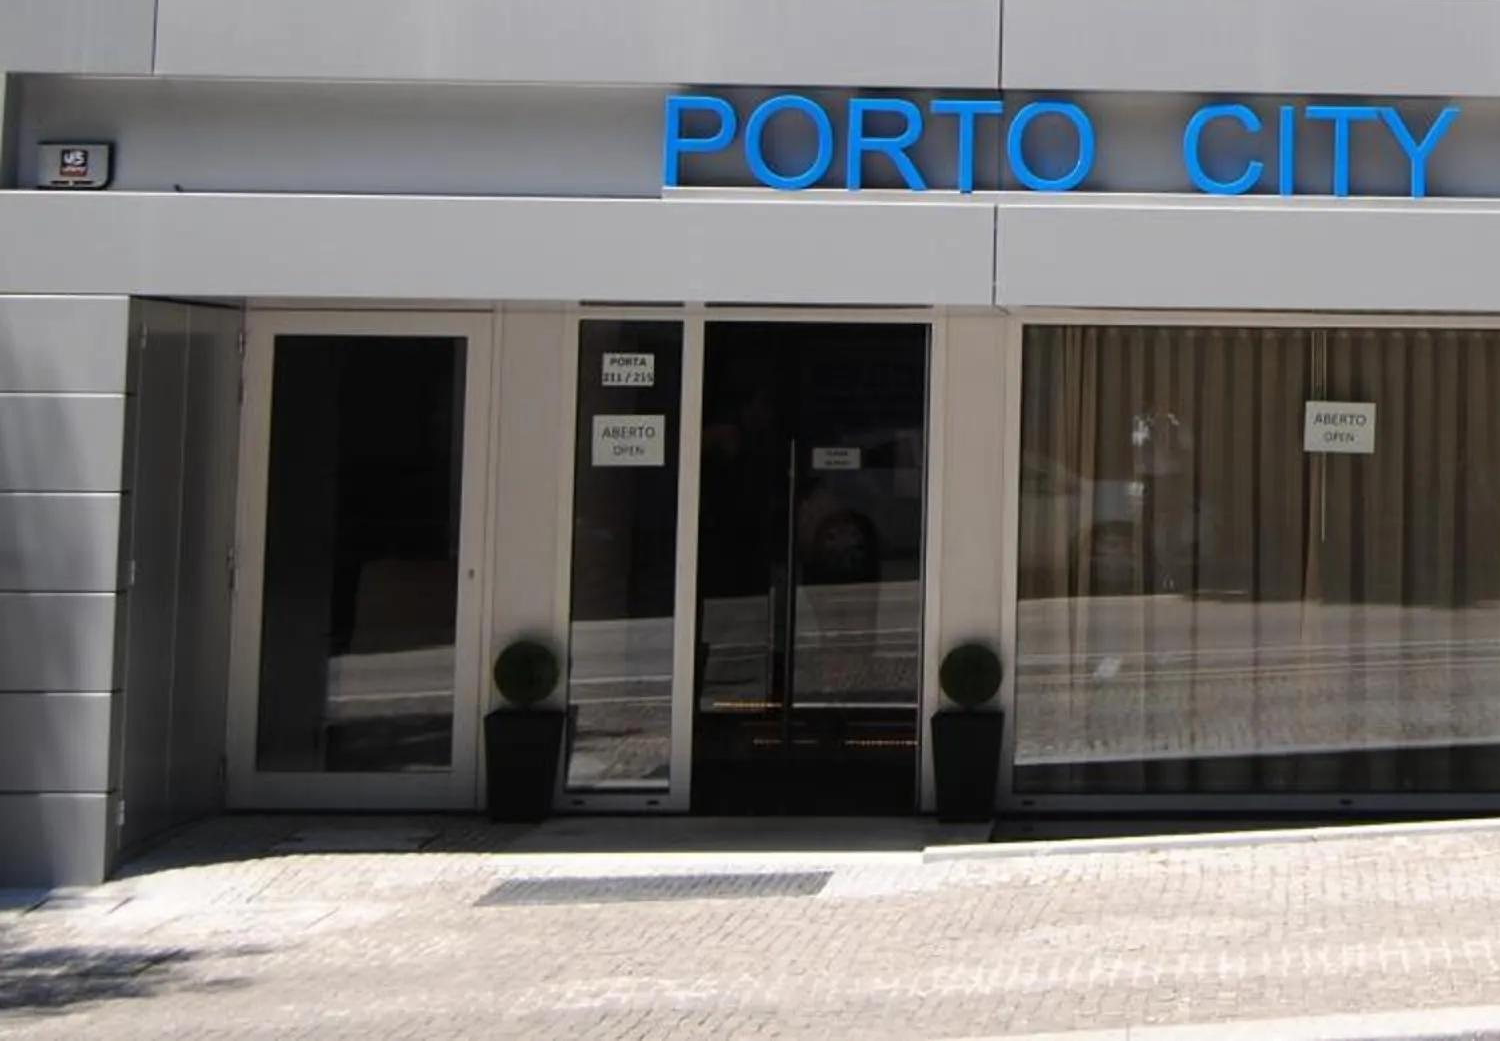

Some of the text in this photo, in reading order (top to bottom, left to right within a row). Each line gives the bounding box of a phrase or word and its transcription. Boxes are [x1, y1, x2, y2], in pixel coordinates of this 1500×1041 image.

[662, 94, 1096, 194] PORTO
[1182, 103, 1459, 200] CITY
[609, 357, 648, 367] PORTA
[1313, 412, 1367, 427] ABERTO
[602, 426, 656, 440] ABERTO
[1323, 431, 1355, 443] OPEN
[612, 445, 645, 457] OPEN
